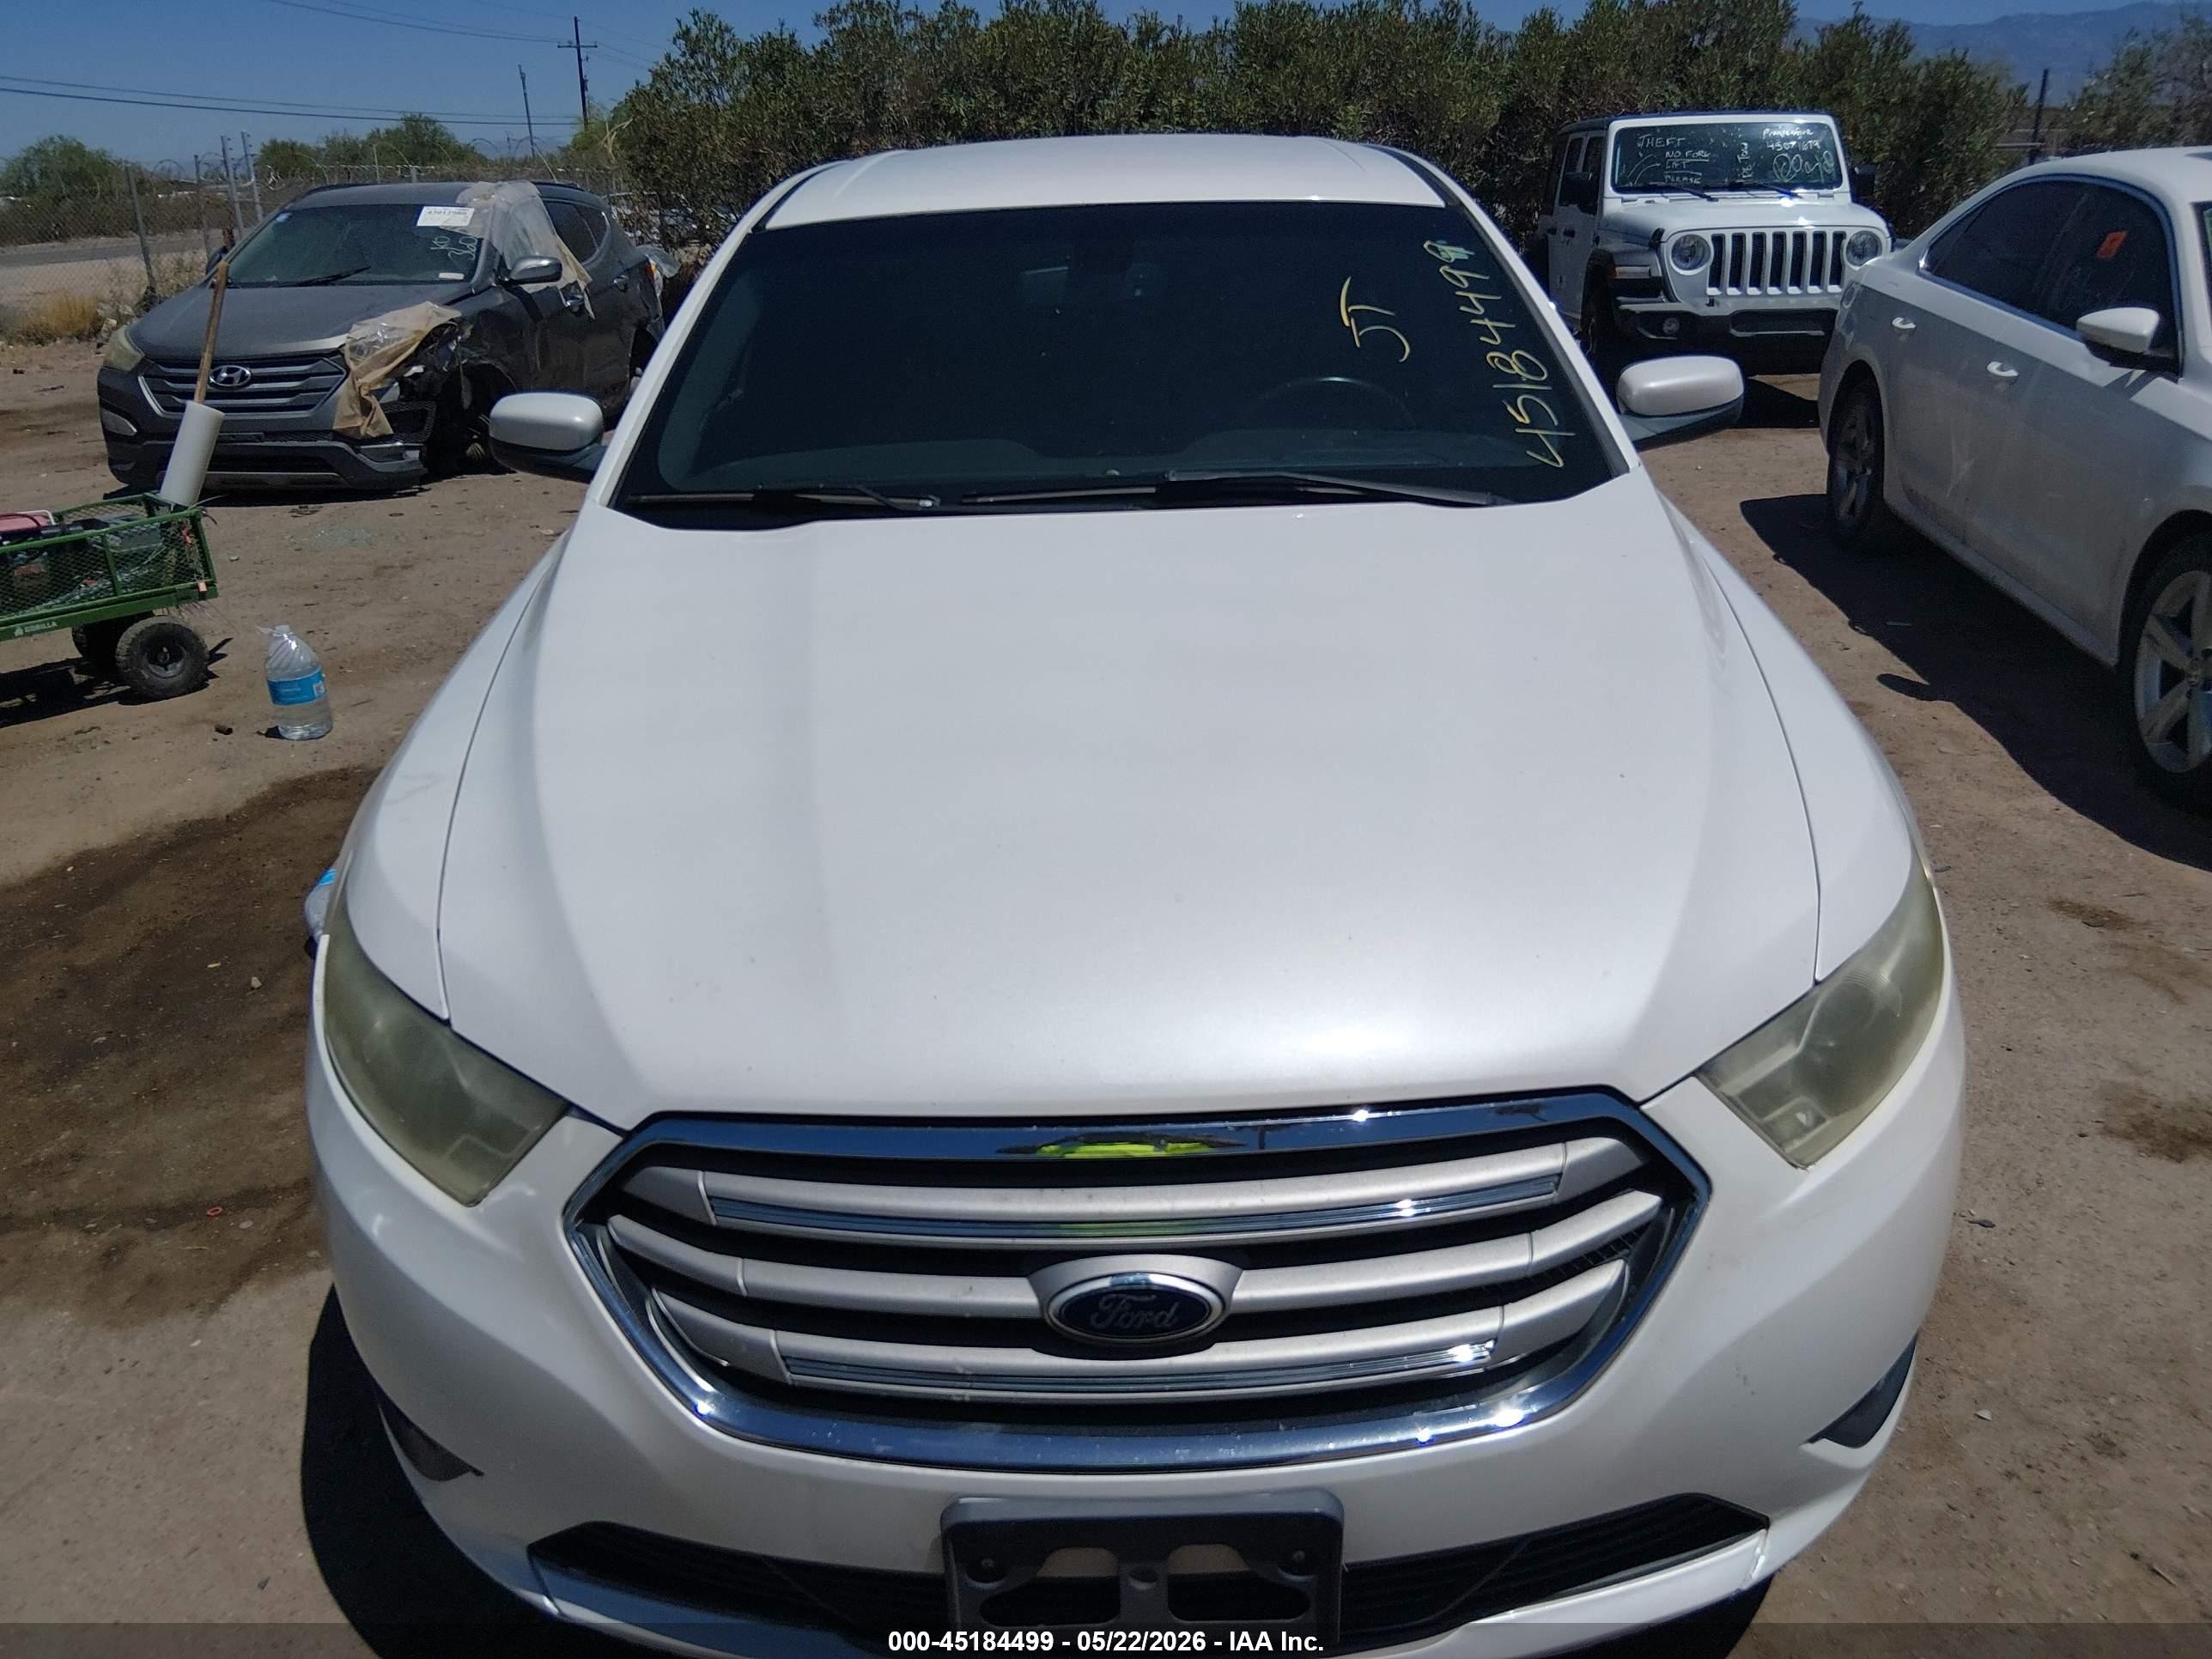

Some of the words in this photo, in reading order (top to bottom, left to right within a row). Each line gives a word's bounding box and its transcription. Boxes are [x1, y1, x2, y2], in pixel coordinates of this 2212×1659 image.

[1638, 133, 1686, 149] THEFT
[1423, 240, 1576, 468] 45184499
[1091, 1292, 1182, 1329] Ford
